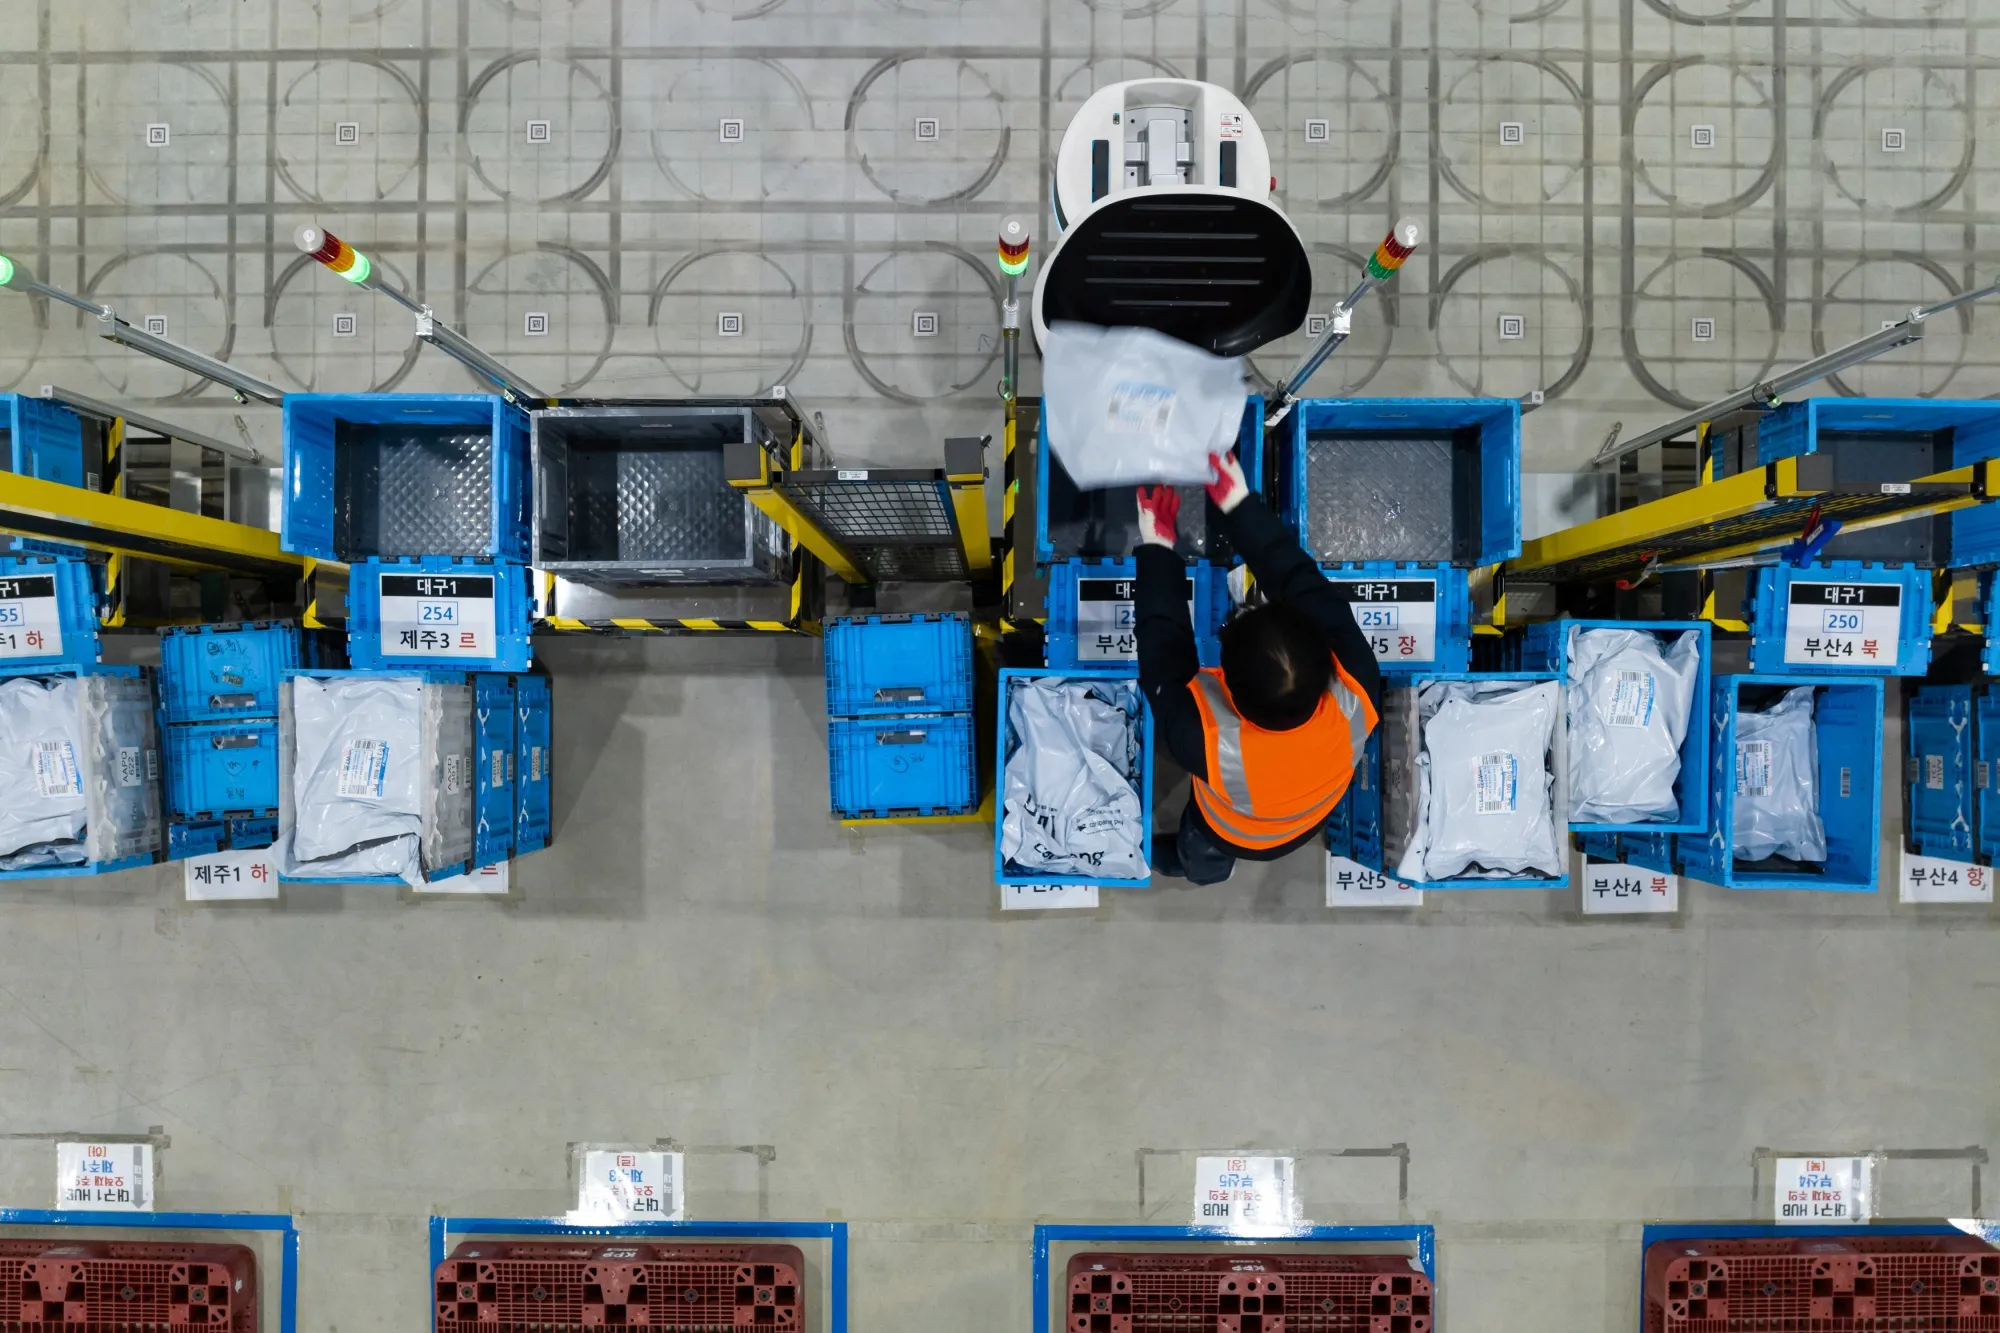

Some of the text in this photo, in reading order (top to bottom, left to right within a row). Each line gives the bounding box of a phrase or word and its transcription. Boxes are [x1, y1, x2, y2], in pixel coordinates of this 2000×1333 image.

[417, 579, 457, 597] 대구1
[1116, 582, 1136, 599] 대
[1357, 583, 1398, 601] 대구1
[1824, 587, 1865, 604] 대구1
[422, 606, 453, 621] 254
[1362, 611, 1392, 626] 251
[1827, 614, 1859, 629] 250
[26, 630, 44, 650] 하
[399, 630, 477, 650] 제주3 르
[1096, 634, 1138, 654] 부산
[1398, 635, 1417, 656] 장
[1803, 638, 1880, 658] 부산4 북
[194, 863, 269, 884] 제주1 하
[1336, 871, 1386, 890] 부산5
[1910, 867, 1985, 887] 부산4 항
[1592, 876, 1668, 898] 부산4 북
[82, 1160, 114, 1174] 제주1
[94, 1175, 124, 1187] 오적재
[1219, 1173, 1253, 1187] 부산5
[1799, 1174, 1832, 1188] 부산4
[97, 1188, 129, 1202] 대구1
[1209, 1190, 1229, 1201] 주의
[1788, 1190, 1842, 1201] 오적재 주의
[1203, 1203, 1229, 1216] HUB
[1782, 1203, 1847, 1217] 대구1 HUB
